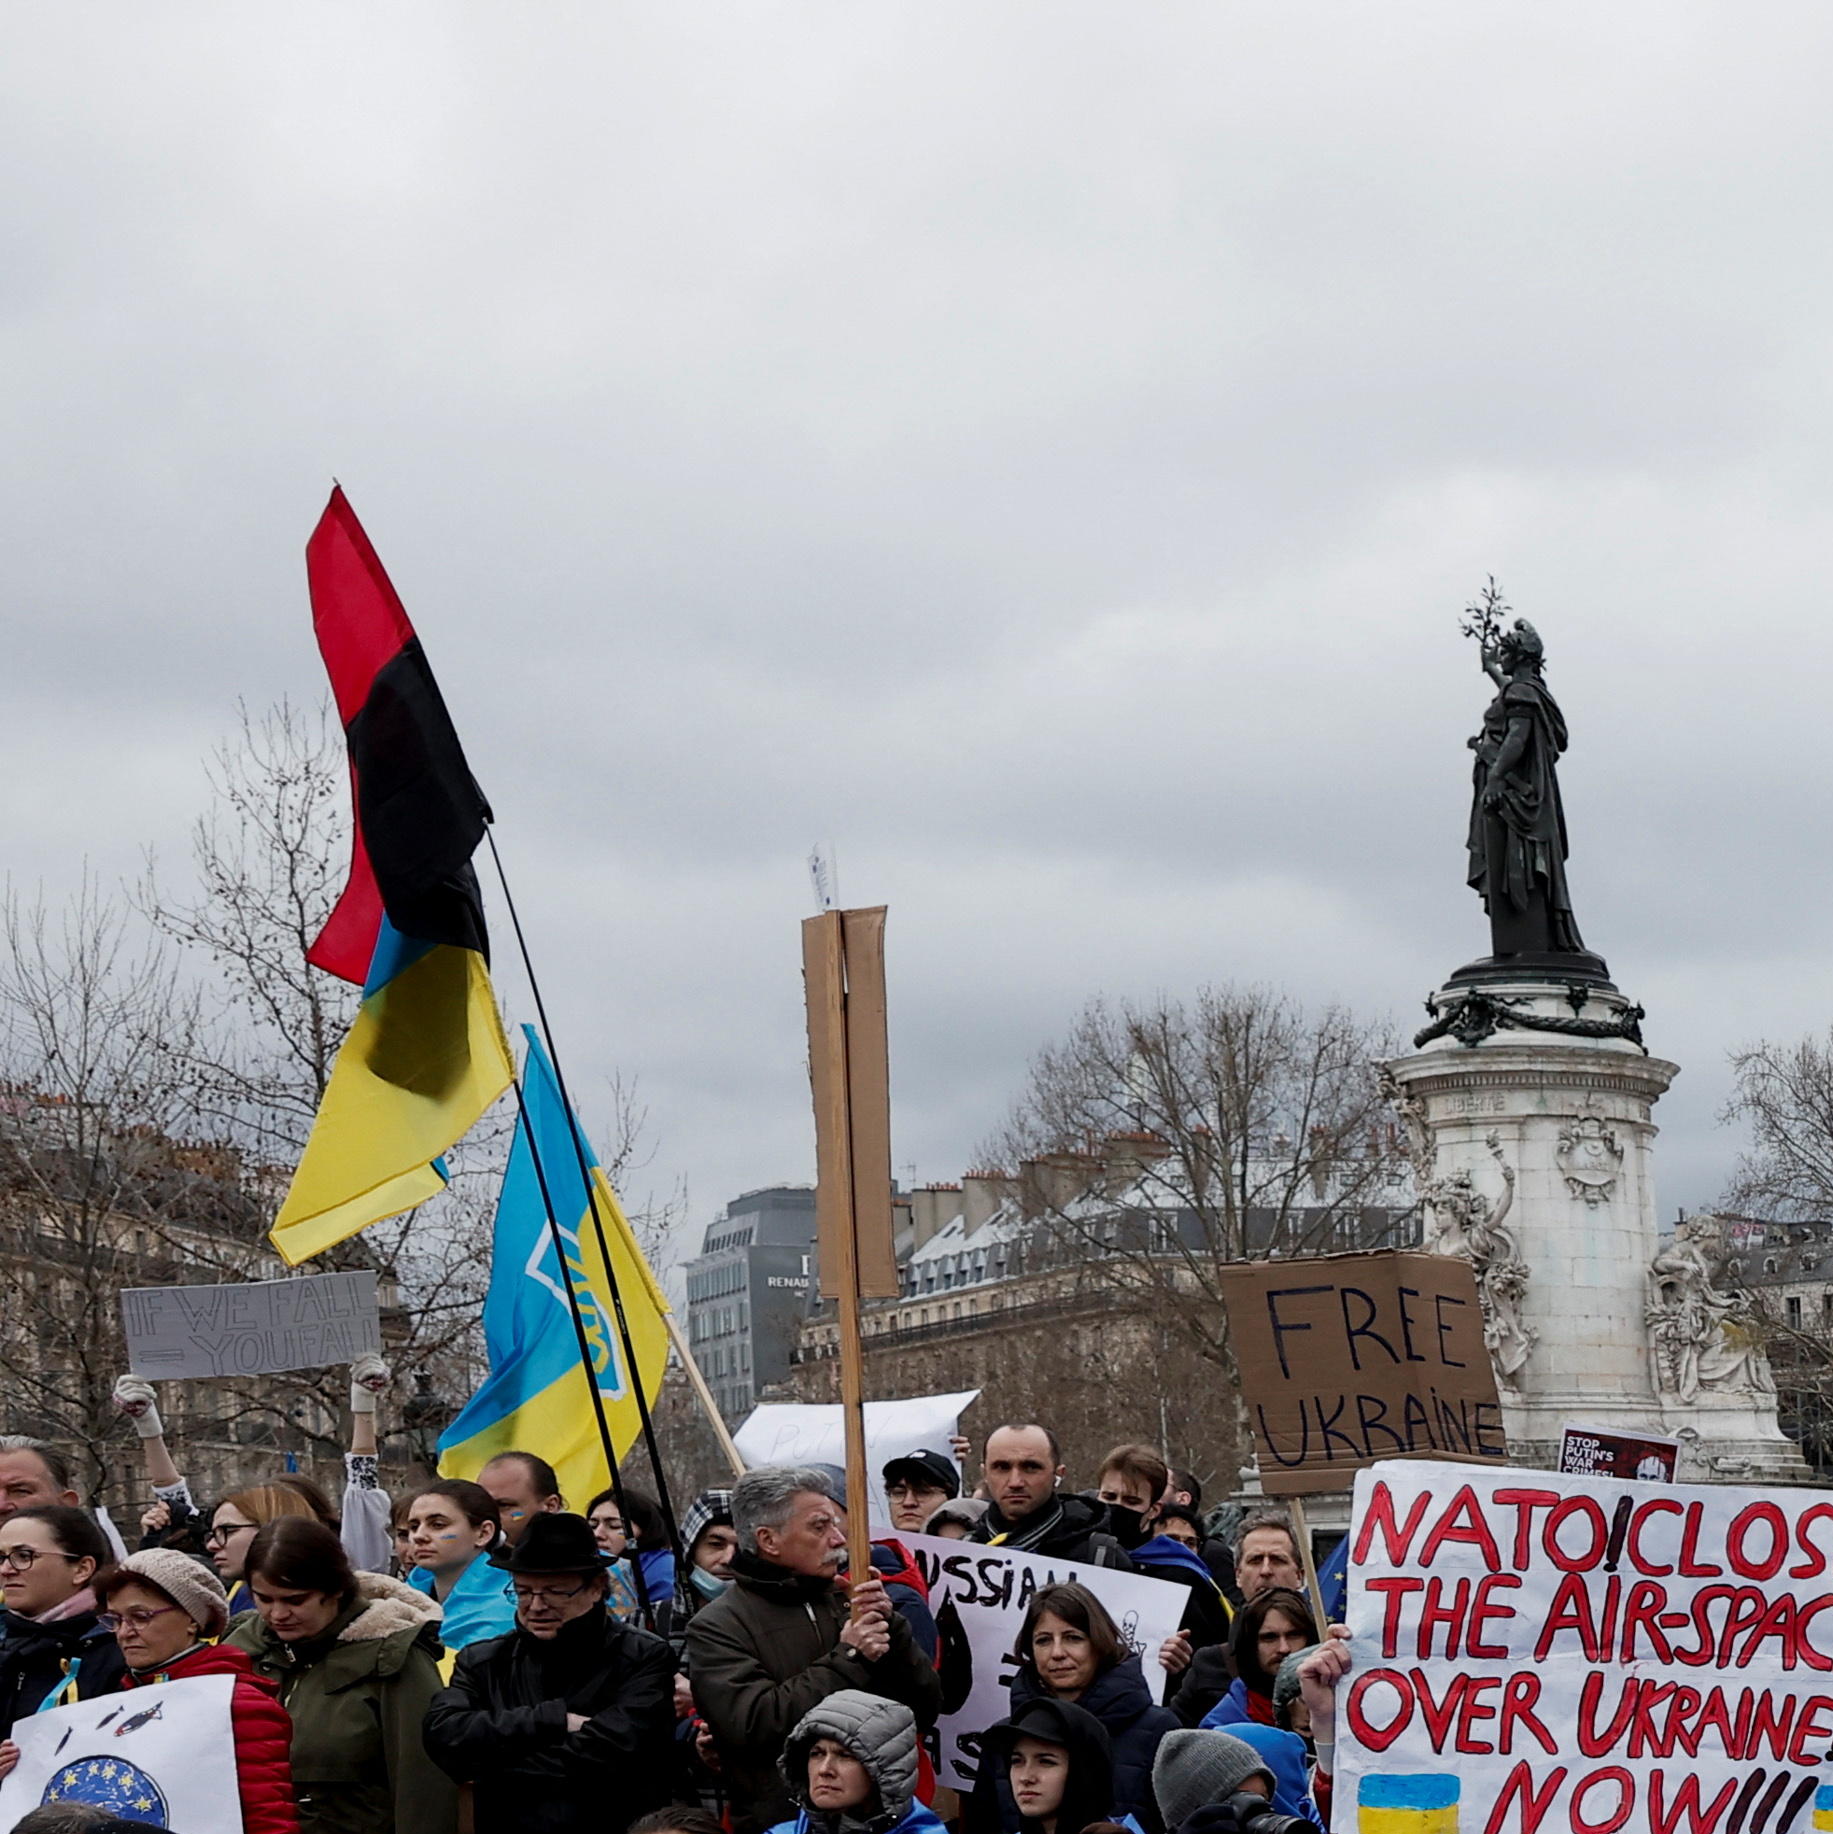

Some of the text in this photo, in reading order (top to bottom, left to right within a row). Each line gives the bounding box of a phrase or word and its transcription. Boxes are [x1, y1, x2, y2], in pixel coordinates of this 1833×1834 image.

[130, 1277, 377, 1336] IF WE FALL
[188, 1329, 294, 1377] YOU
[1266, 1285, 1466, 1379] FREE
[767, 1415, 893, 1465] PUTN
[1564, 1455, 1594, 1469] WAR
[1565, 1446, 1614, 1462] PUTIN'S
[1566, 1435, 1600, 1449] STOP
[1562, 1465, 1614, 1478] CRIMES!
[1365, 1574, 1522, 1660] THE
[1346, 1668, 1559, 1756] OVER
